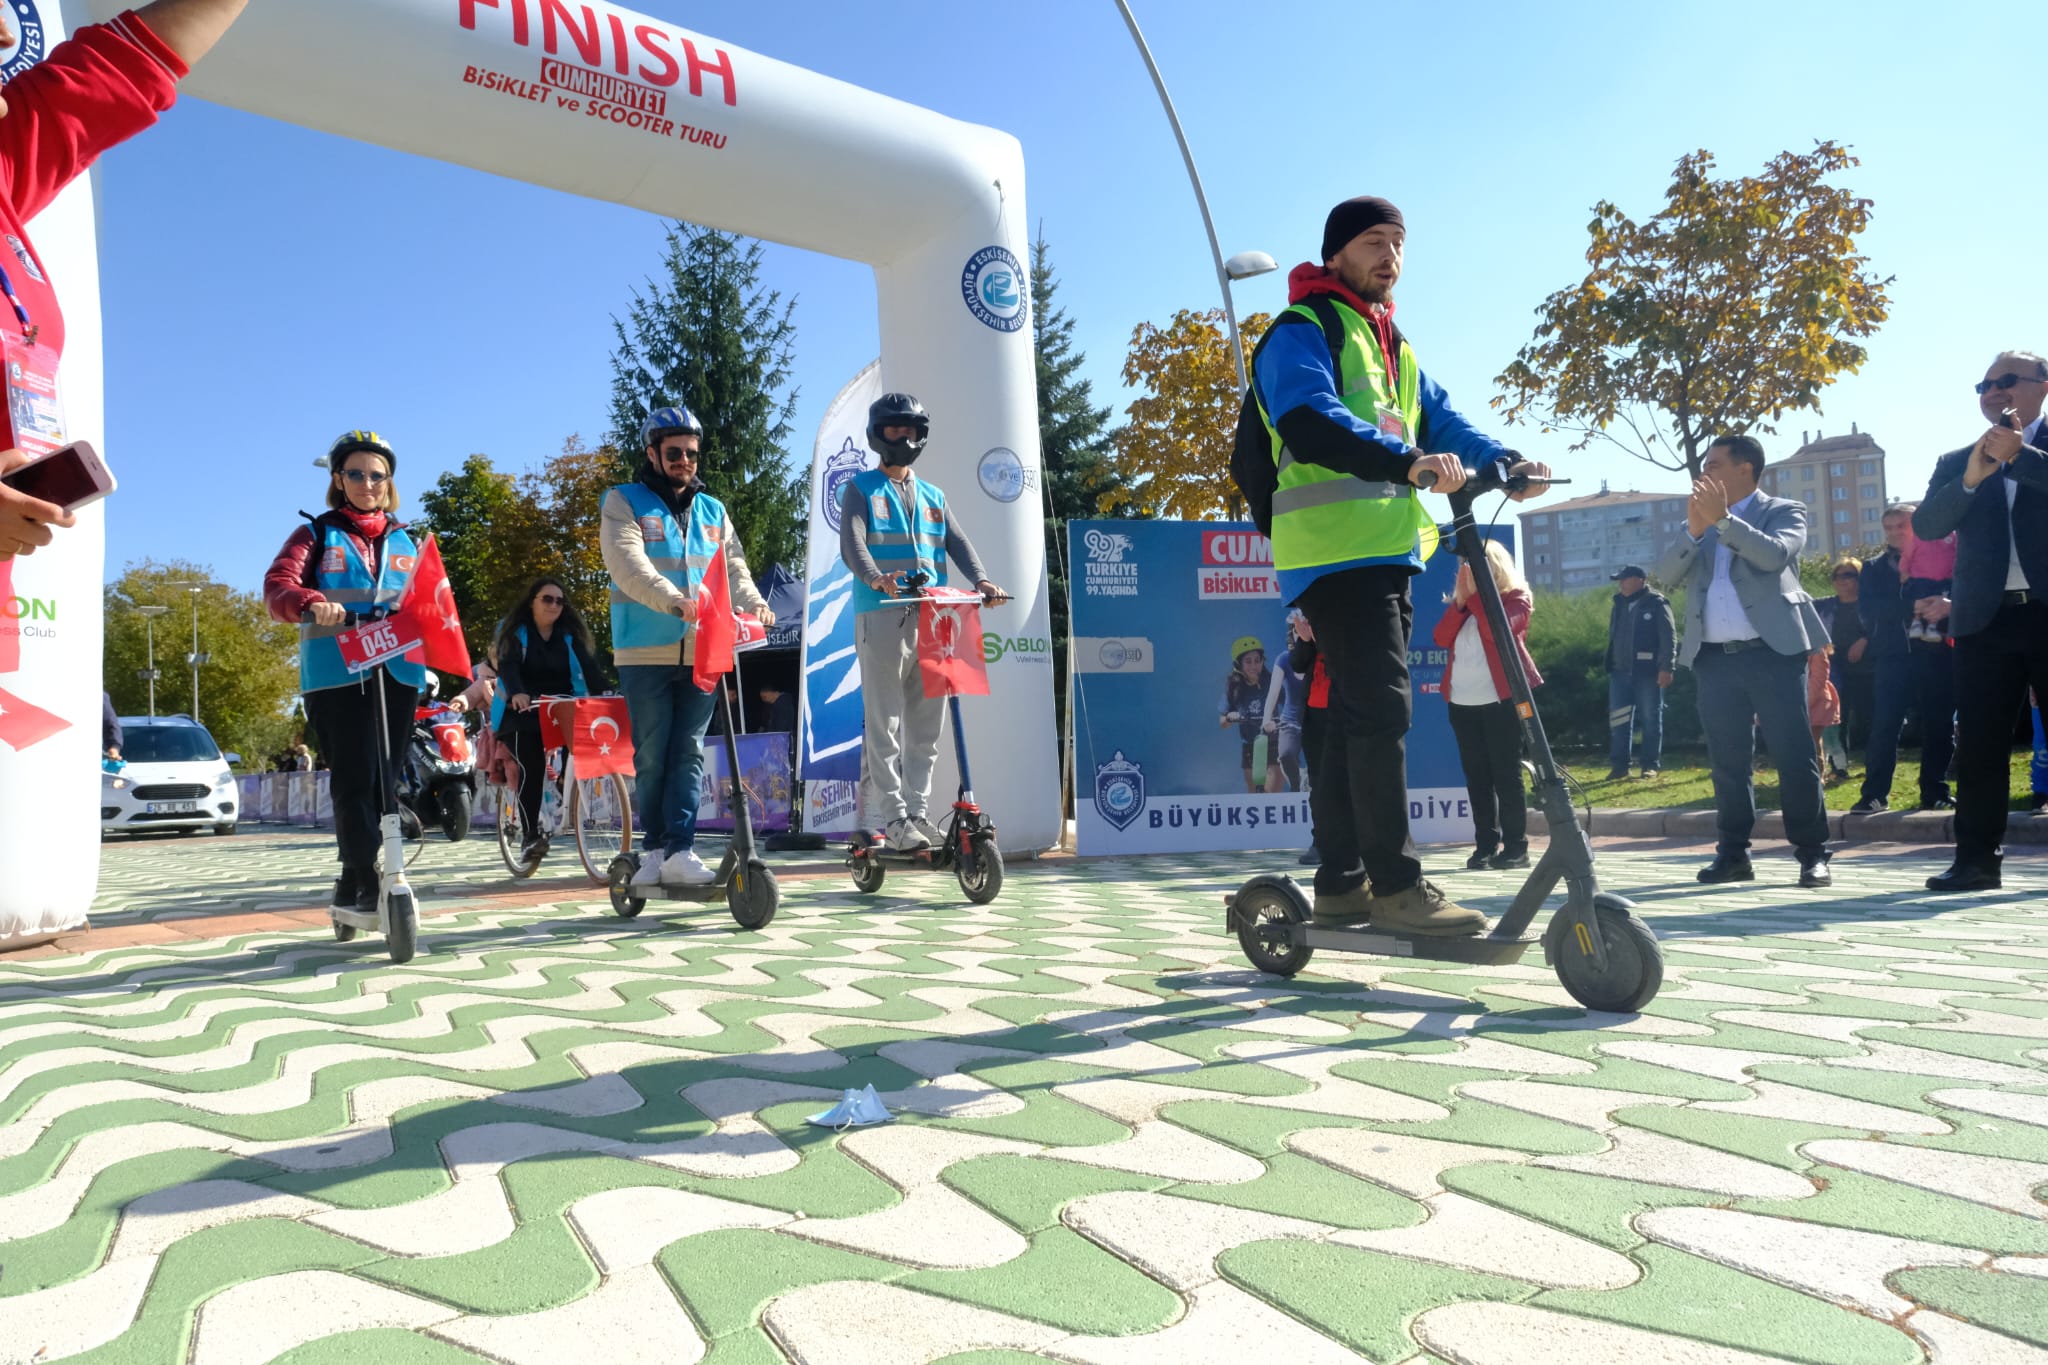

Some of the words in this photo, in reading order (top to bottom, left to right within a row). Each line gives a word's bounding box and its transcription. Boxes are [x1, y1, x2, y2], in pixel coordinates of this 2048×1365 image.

[557, 95, 580, 112] ve
[586, 101, 674, 136] SCOOTER
[680, 124, 727, 149] TURU
[1210, 534, 1274, 563] CUM
[23, 625, 57, 639] Club
[361, 625, 399, 657] 045
[1407, 650, 1422, 664] 29
[1149, 800, 1308, 829] BÜYÜKŞEHİ
